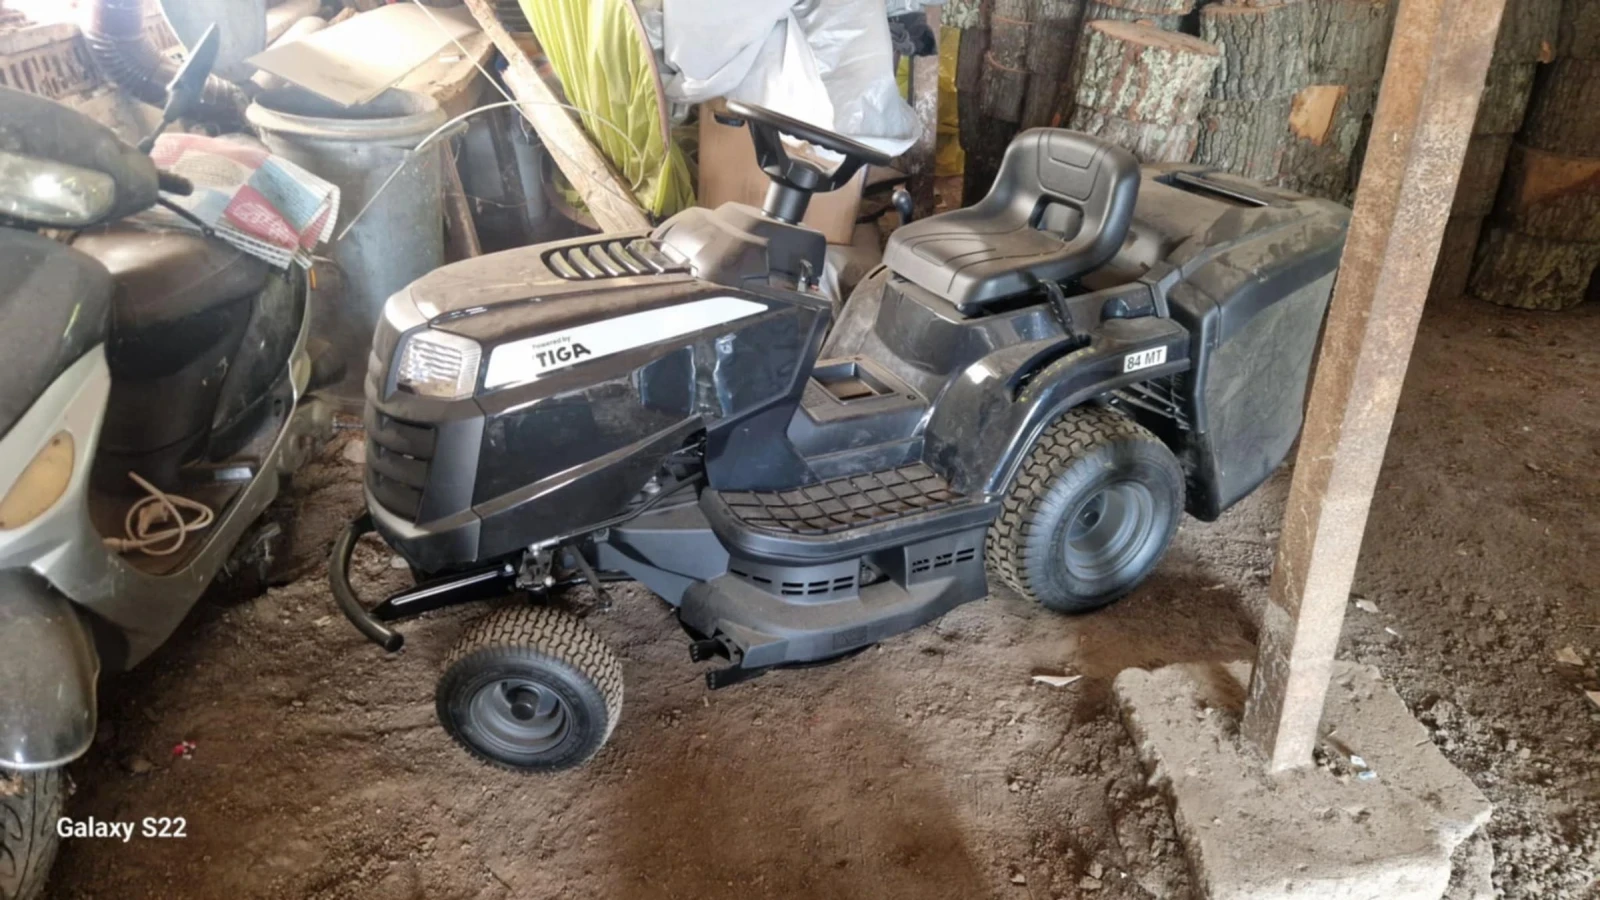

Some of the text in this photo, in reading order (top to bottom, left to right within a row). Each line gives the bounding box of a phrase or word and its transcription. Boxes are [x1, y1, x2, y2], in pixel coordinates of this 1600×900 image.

[535, 343, 592, 368] TIGA
[1127, 350, 1163, 370] 84 MT
